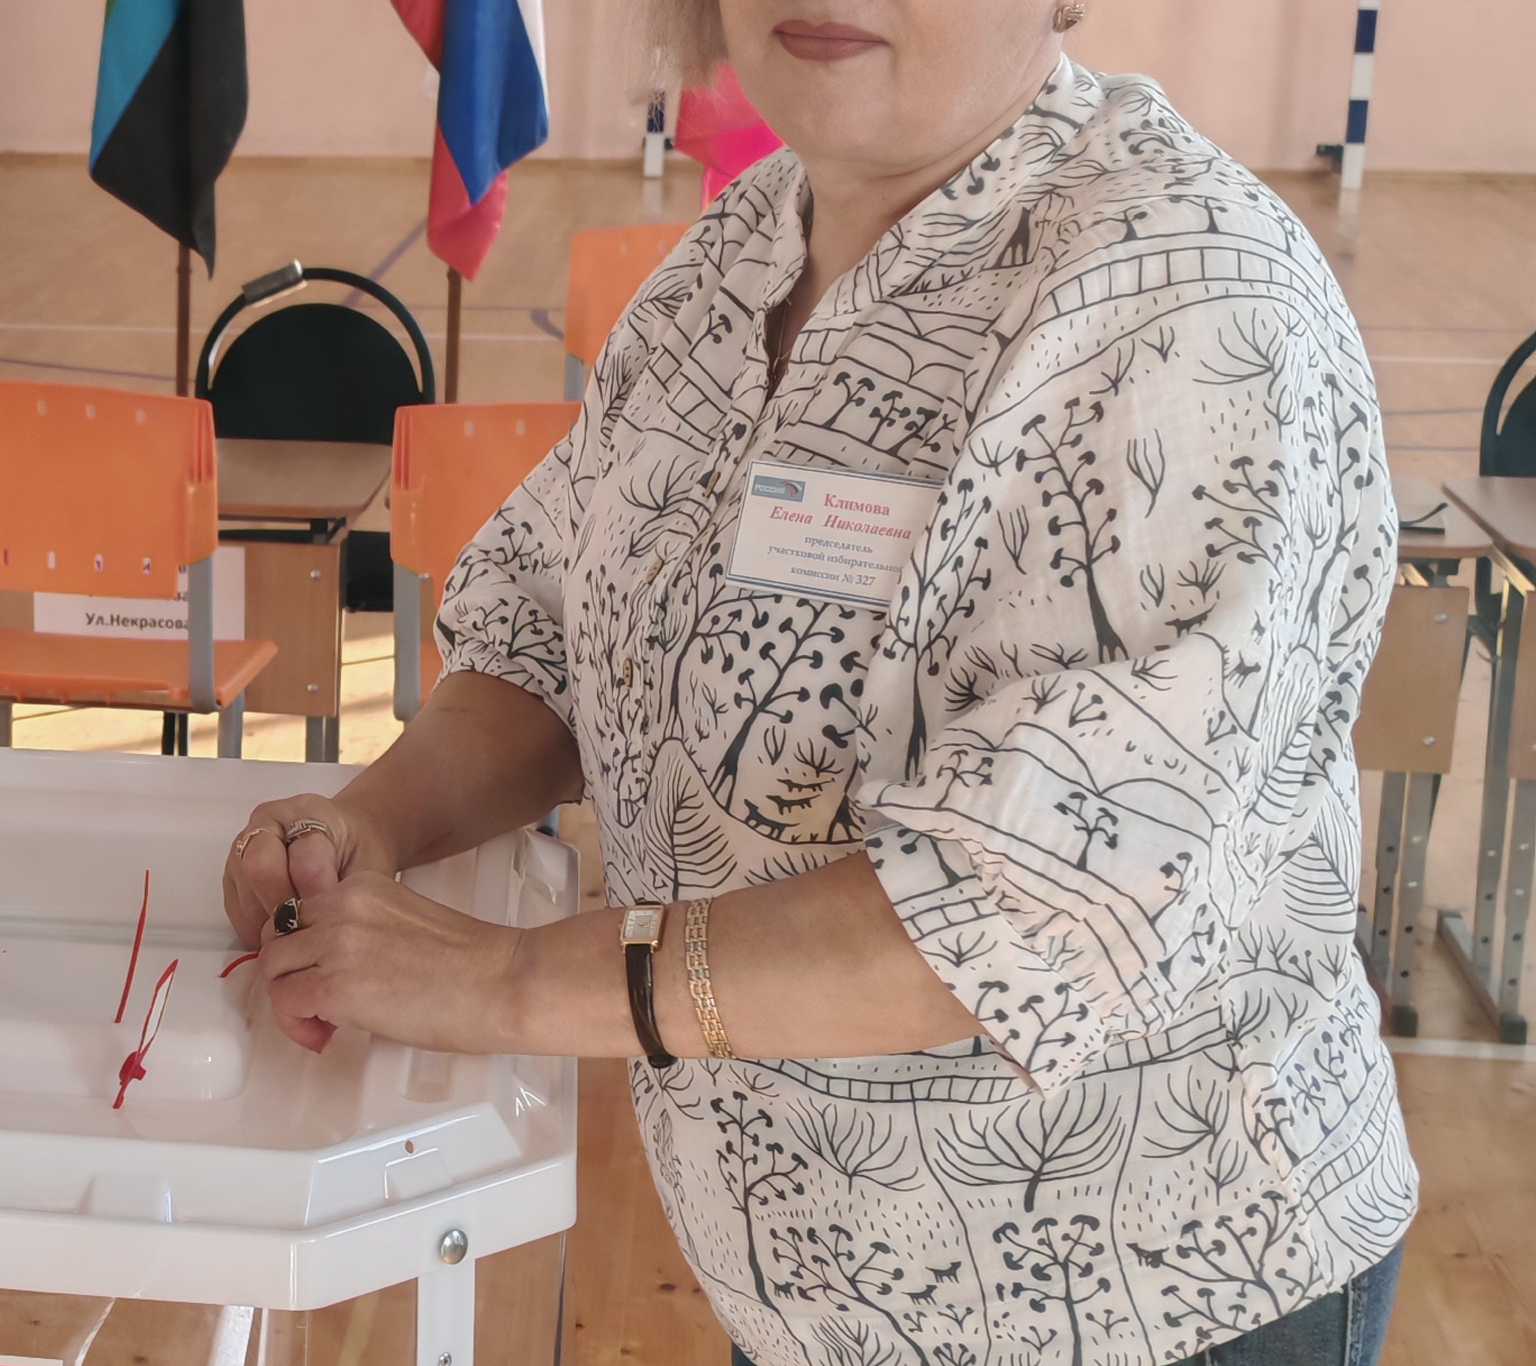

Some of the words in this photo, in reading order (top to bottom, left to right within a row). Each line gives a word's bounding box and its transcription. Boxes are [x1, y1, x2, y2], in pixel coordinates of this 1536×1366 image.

[824, 493, 890, 516] Климова
[769, 506, 814, 524] Елена
[823, 514, 912, 540] Николаевна
[767, 545, 826, 561] участковой
[805, 536, 873, 553] председатель
[790, 566, 839, 582] комиссии
[855, 574, 876, 586] 327
